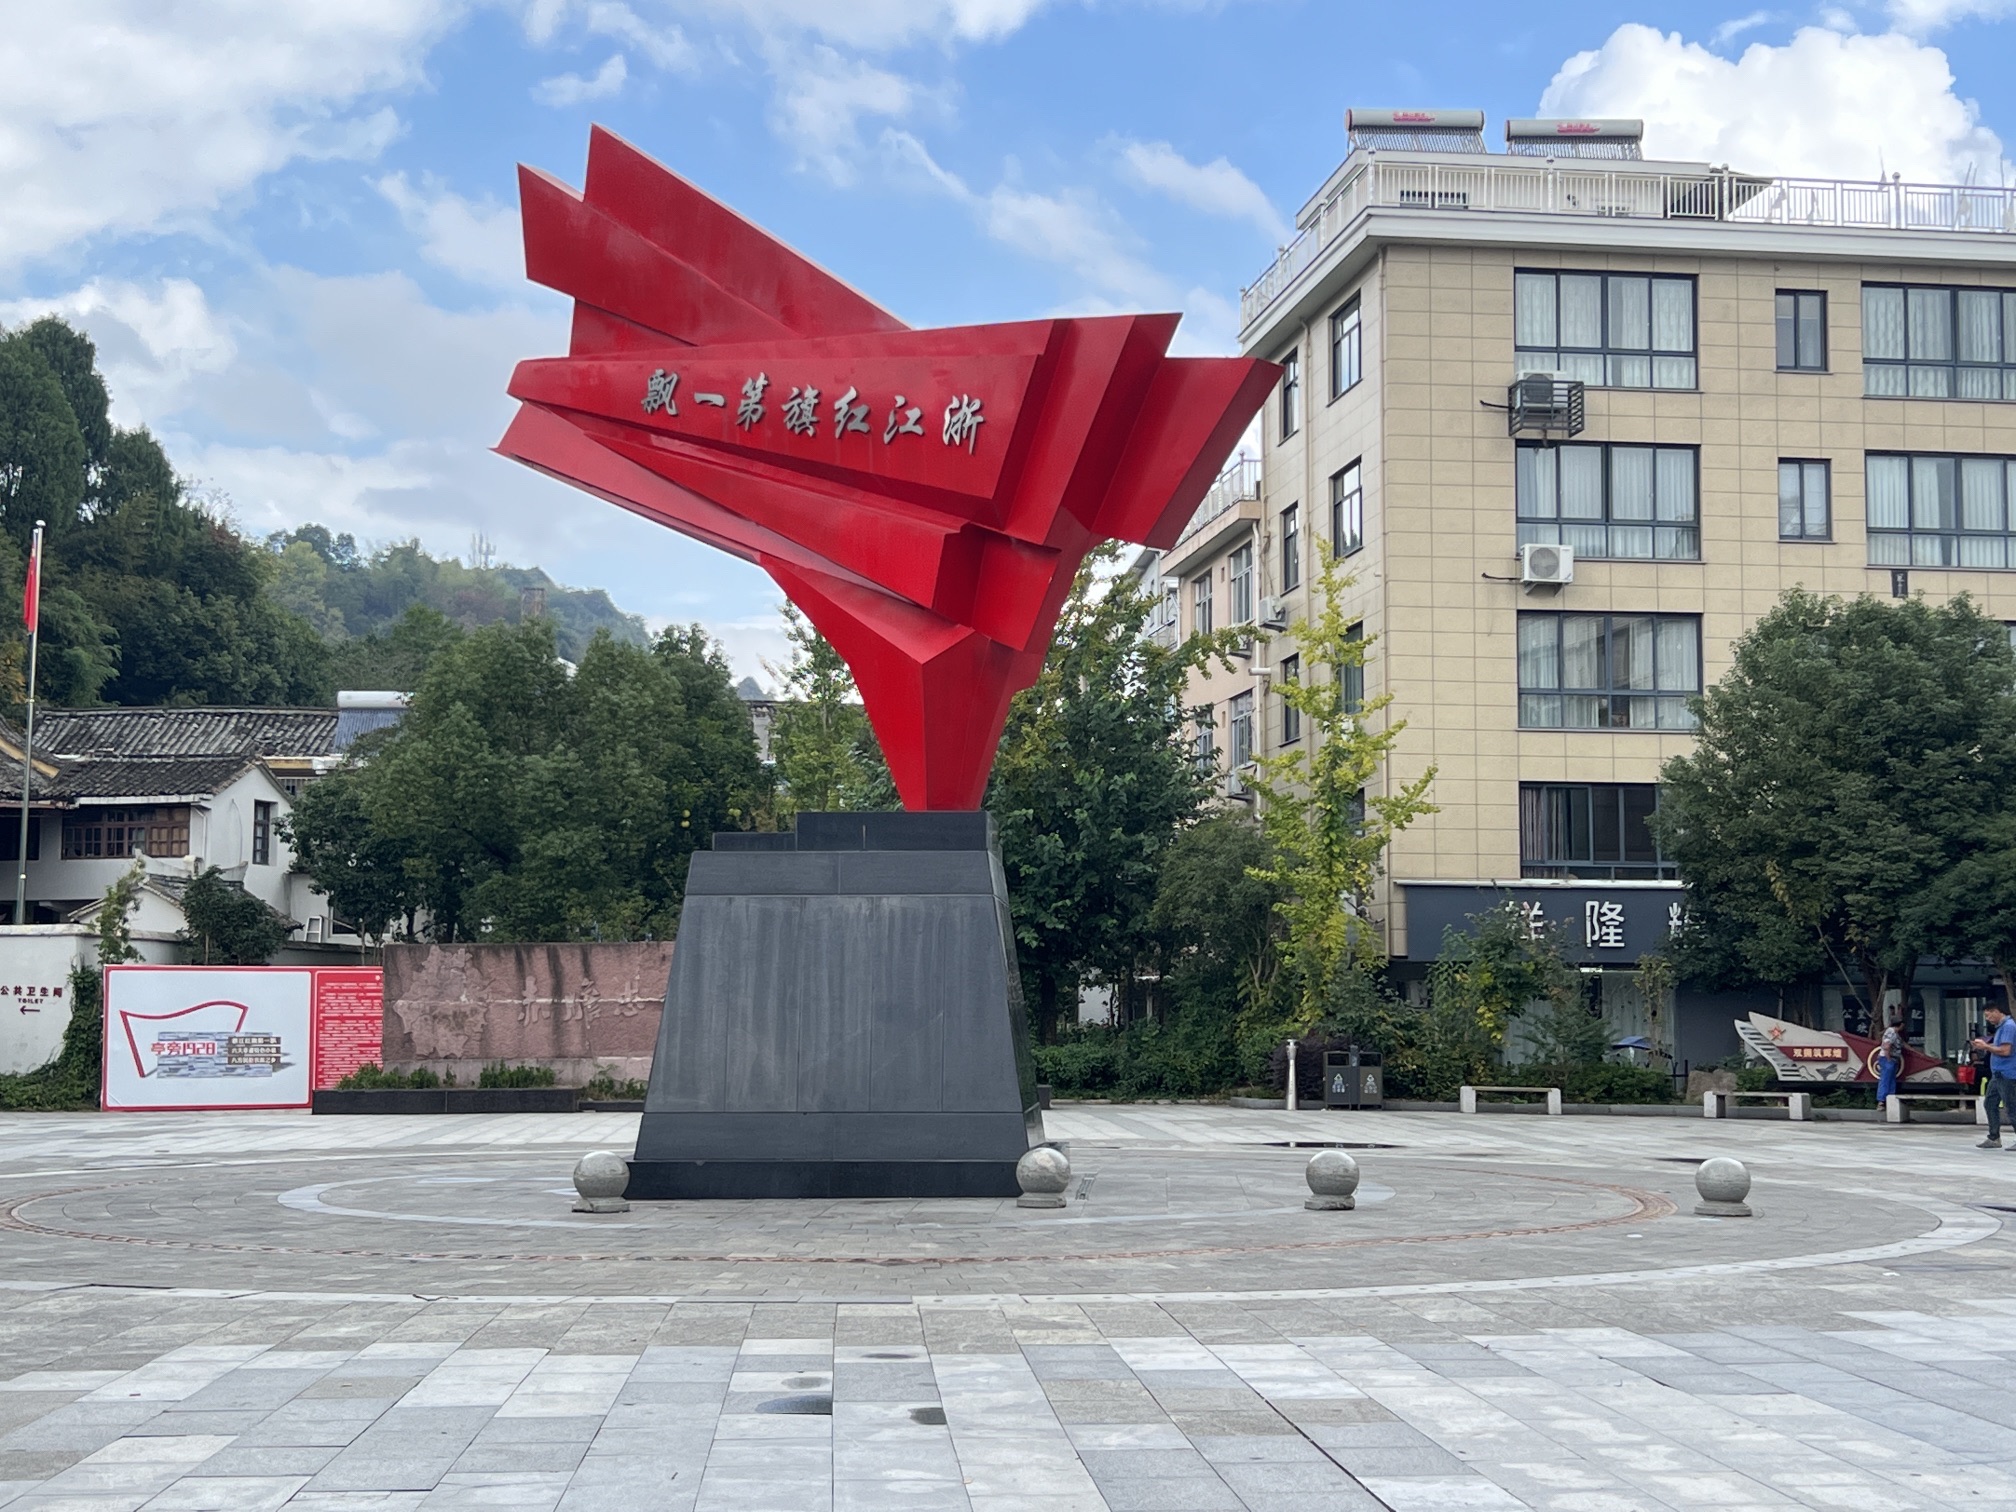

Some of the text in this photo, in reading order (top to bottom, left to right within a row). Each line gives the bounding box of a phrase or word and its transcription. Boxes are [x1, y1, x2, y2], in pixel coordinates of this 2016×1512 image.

[0, 985, 63, 998] 公共卫生间
